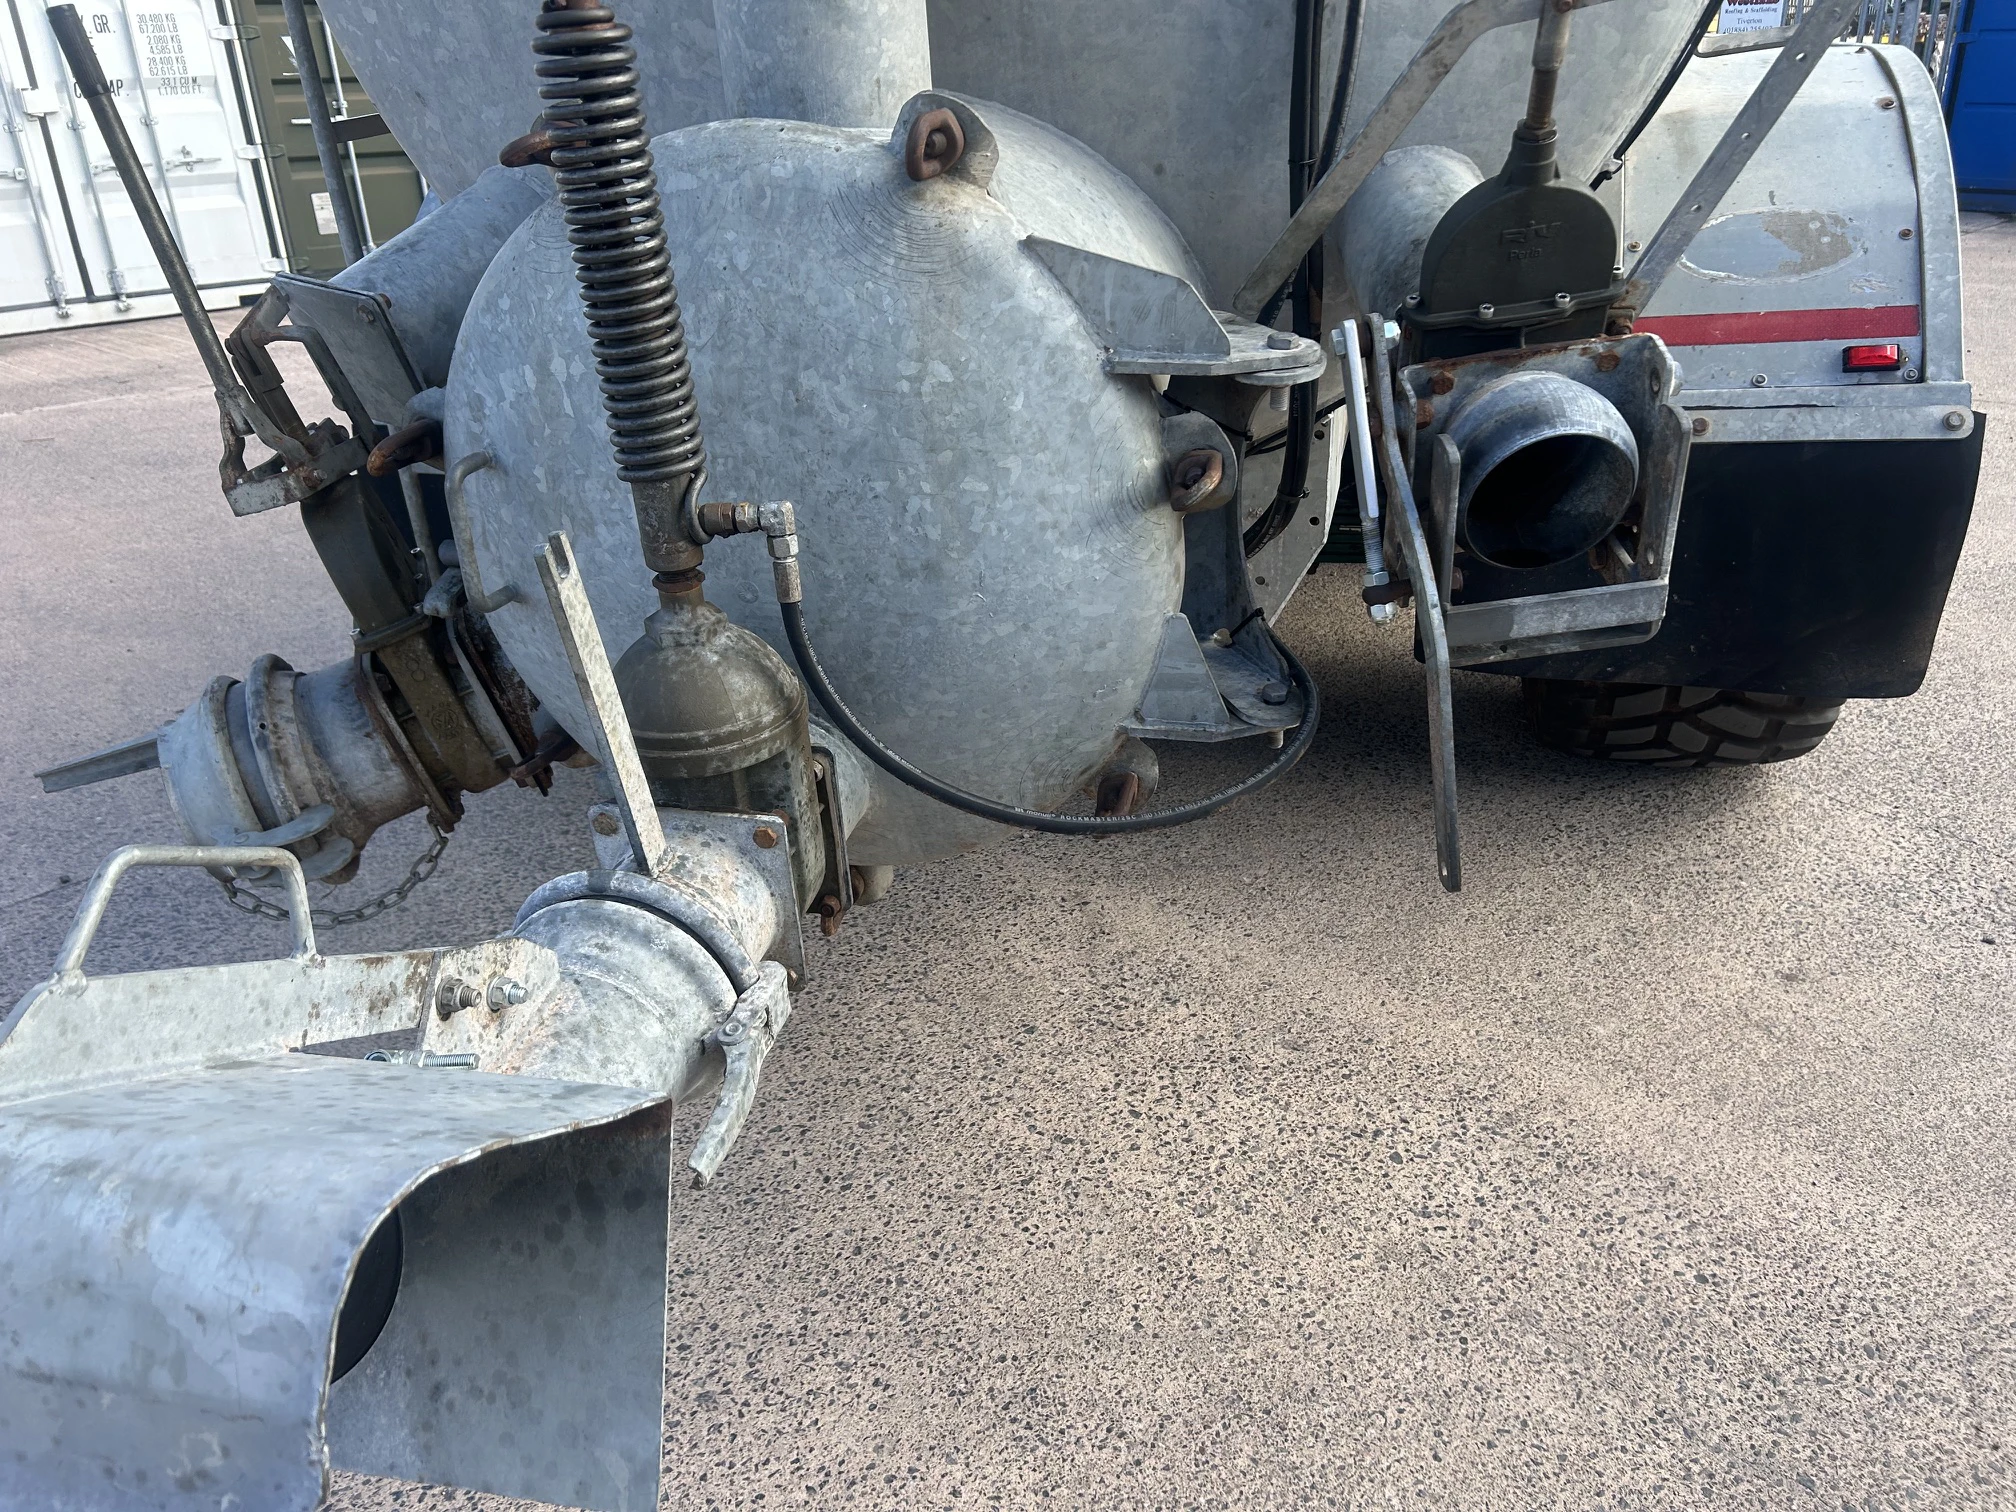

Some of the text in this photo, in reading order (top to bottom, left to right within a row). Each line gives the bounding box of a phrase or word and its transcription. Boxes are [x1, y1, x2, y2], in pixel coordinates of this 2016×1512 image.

[136, 13, 176, 24] 30.480 KG
[138, 23, 179, 34] 67.200 LB
[146, 34, 182, 45] 2.080 KG
[149, 44, 184, 55] 4.585 LB
[147, 56, 187, 67] 28.400 KG
[149, 65, 188, 77] 62.615 LB
